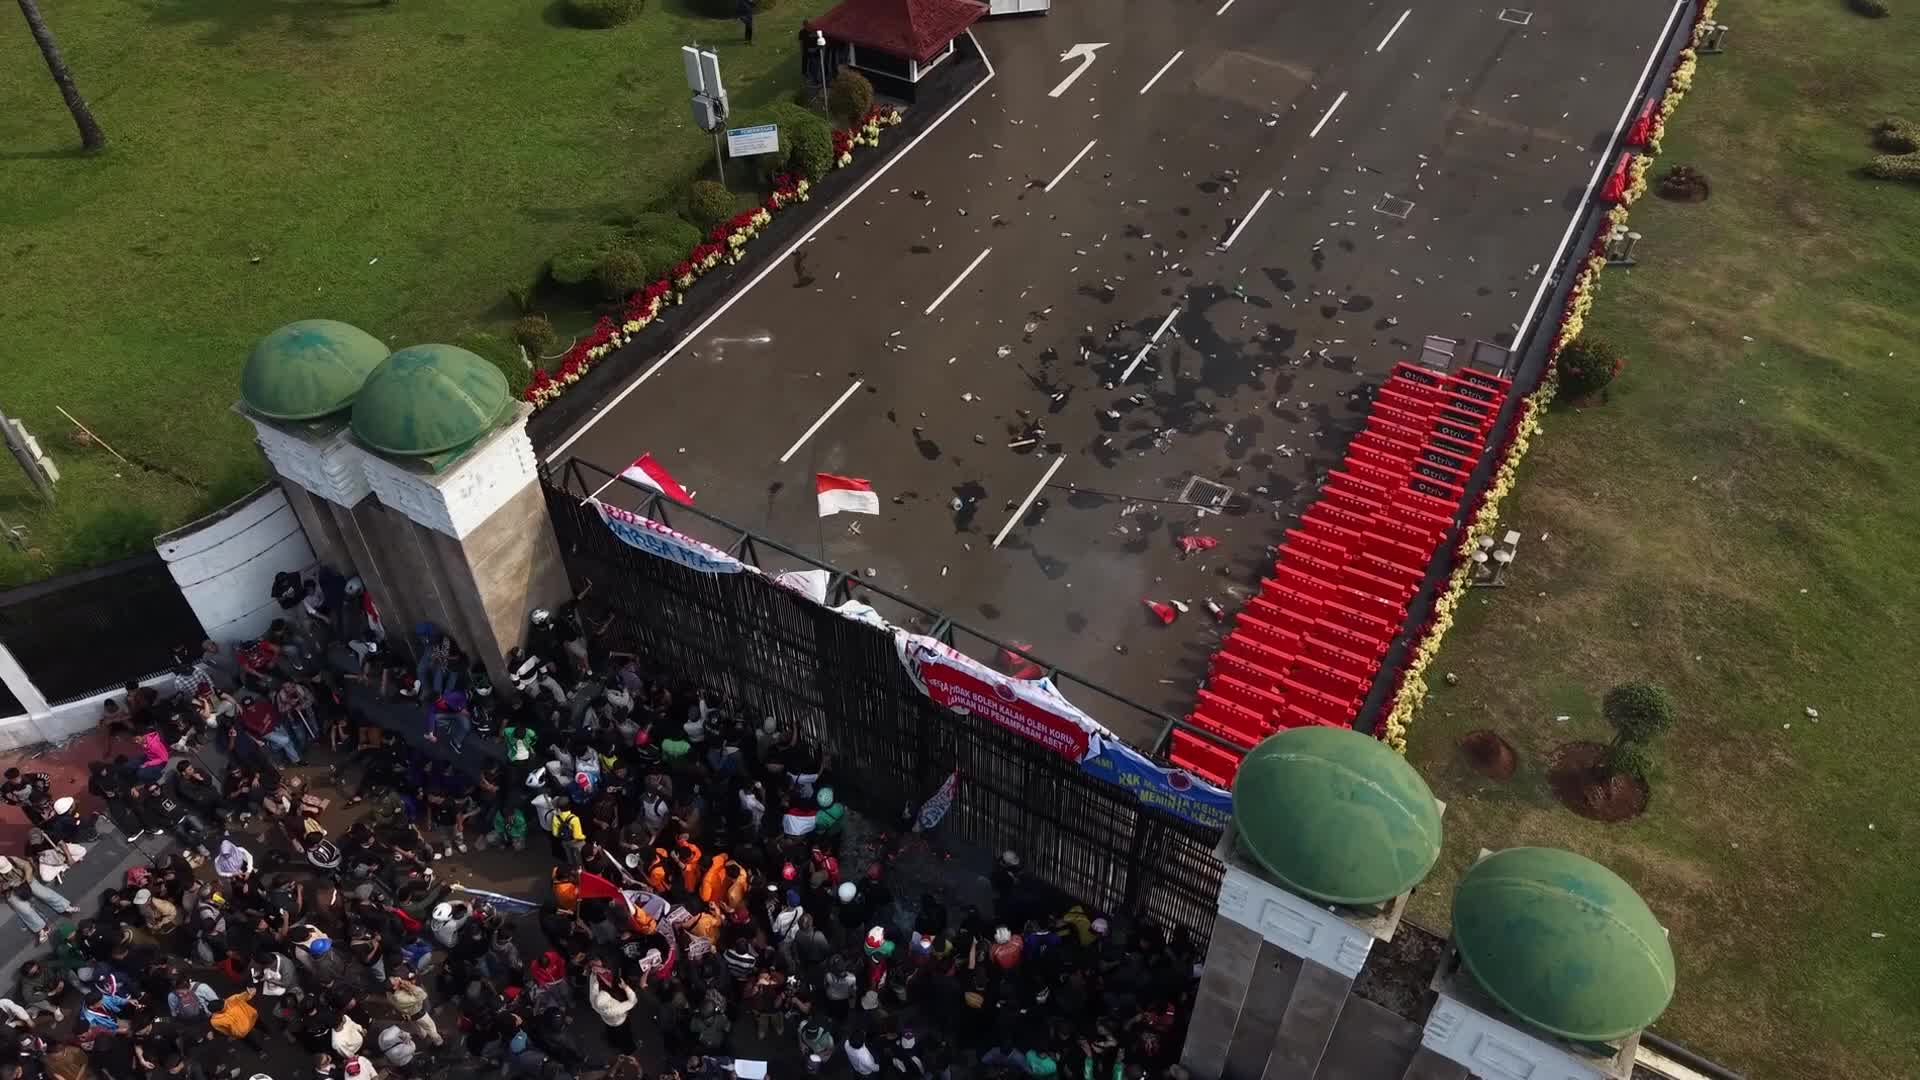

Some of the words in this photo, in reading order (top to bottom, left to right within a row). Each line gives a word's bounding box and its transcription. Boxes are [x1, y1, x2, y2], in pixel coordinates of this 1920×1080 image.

[972, 693, 997, 710] BOLEH
[999, 703, 1025, 723] KALAH
[1027, 718, 1047, 734] OLEH
[978, 704, 989, 715] UU
[990, 710, 1042, 740] PERAMPASAN
[1043, 735, 1063, 750] ASET
